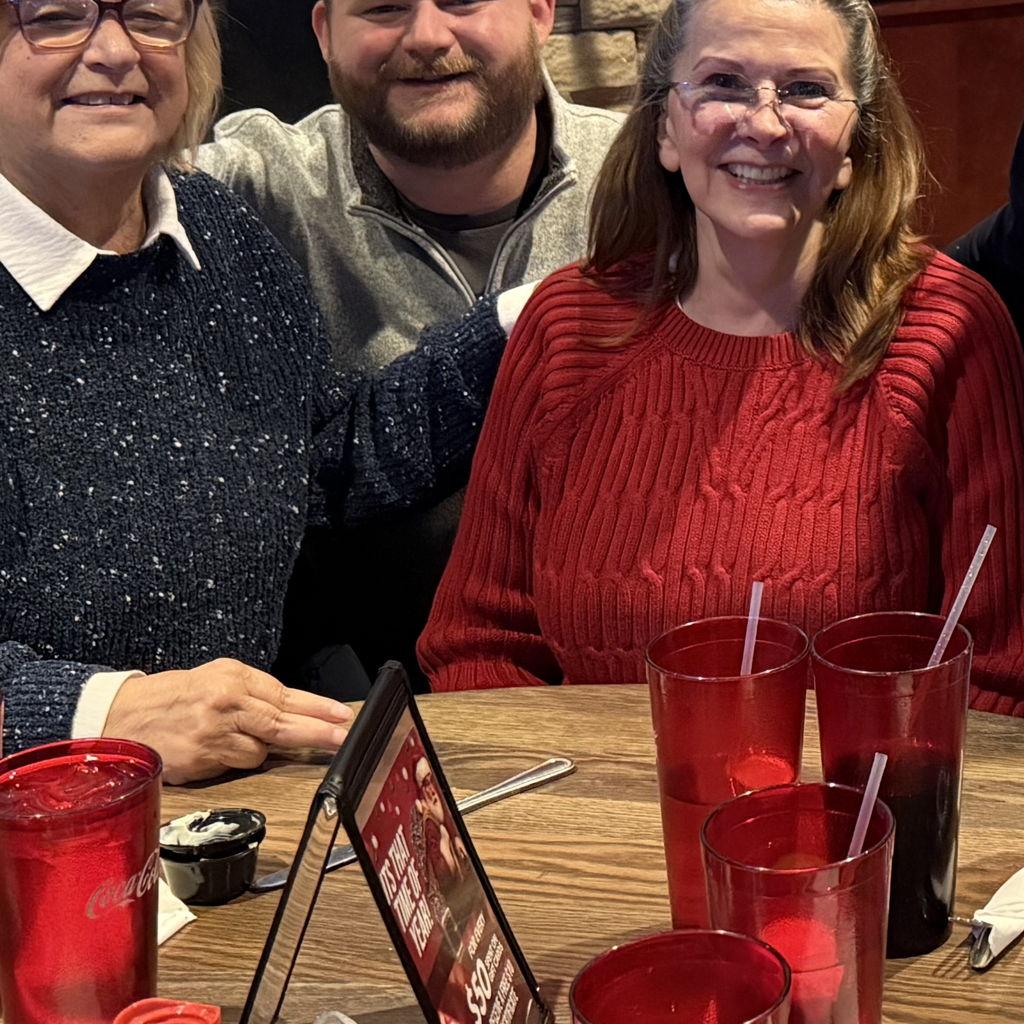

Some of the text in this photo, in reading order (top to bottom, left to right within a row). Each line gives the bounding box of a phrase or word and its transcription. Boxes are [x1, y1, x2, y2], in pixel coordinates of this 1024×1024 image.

[388, 823, 410, 880] THAT
[393, 857, 422, 933] TIME OF
[409, 894, 434, 958] YEAR!
[464, 958, 492, 1024] $50
